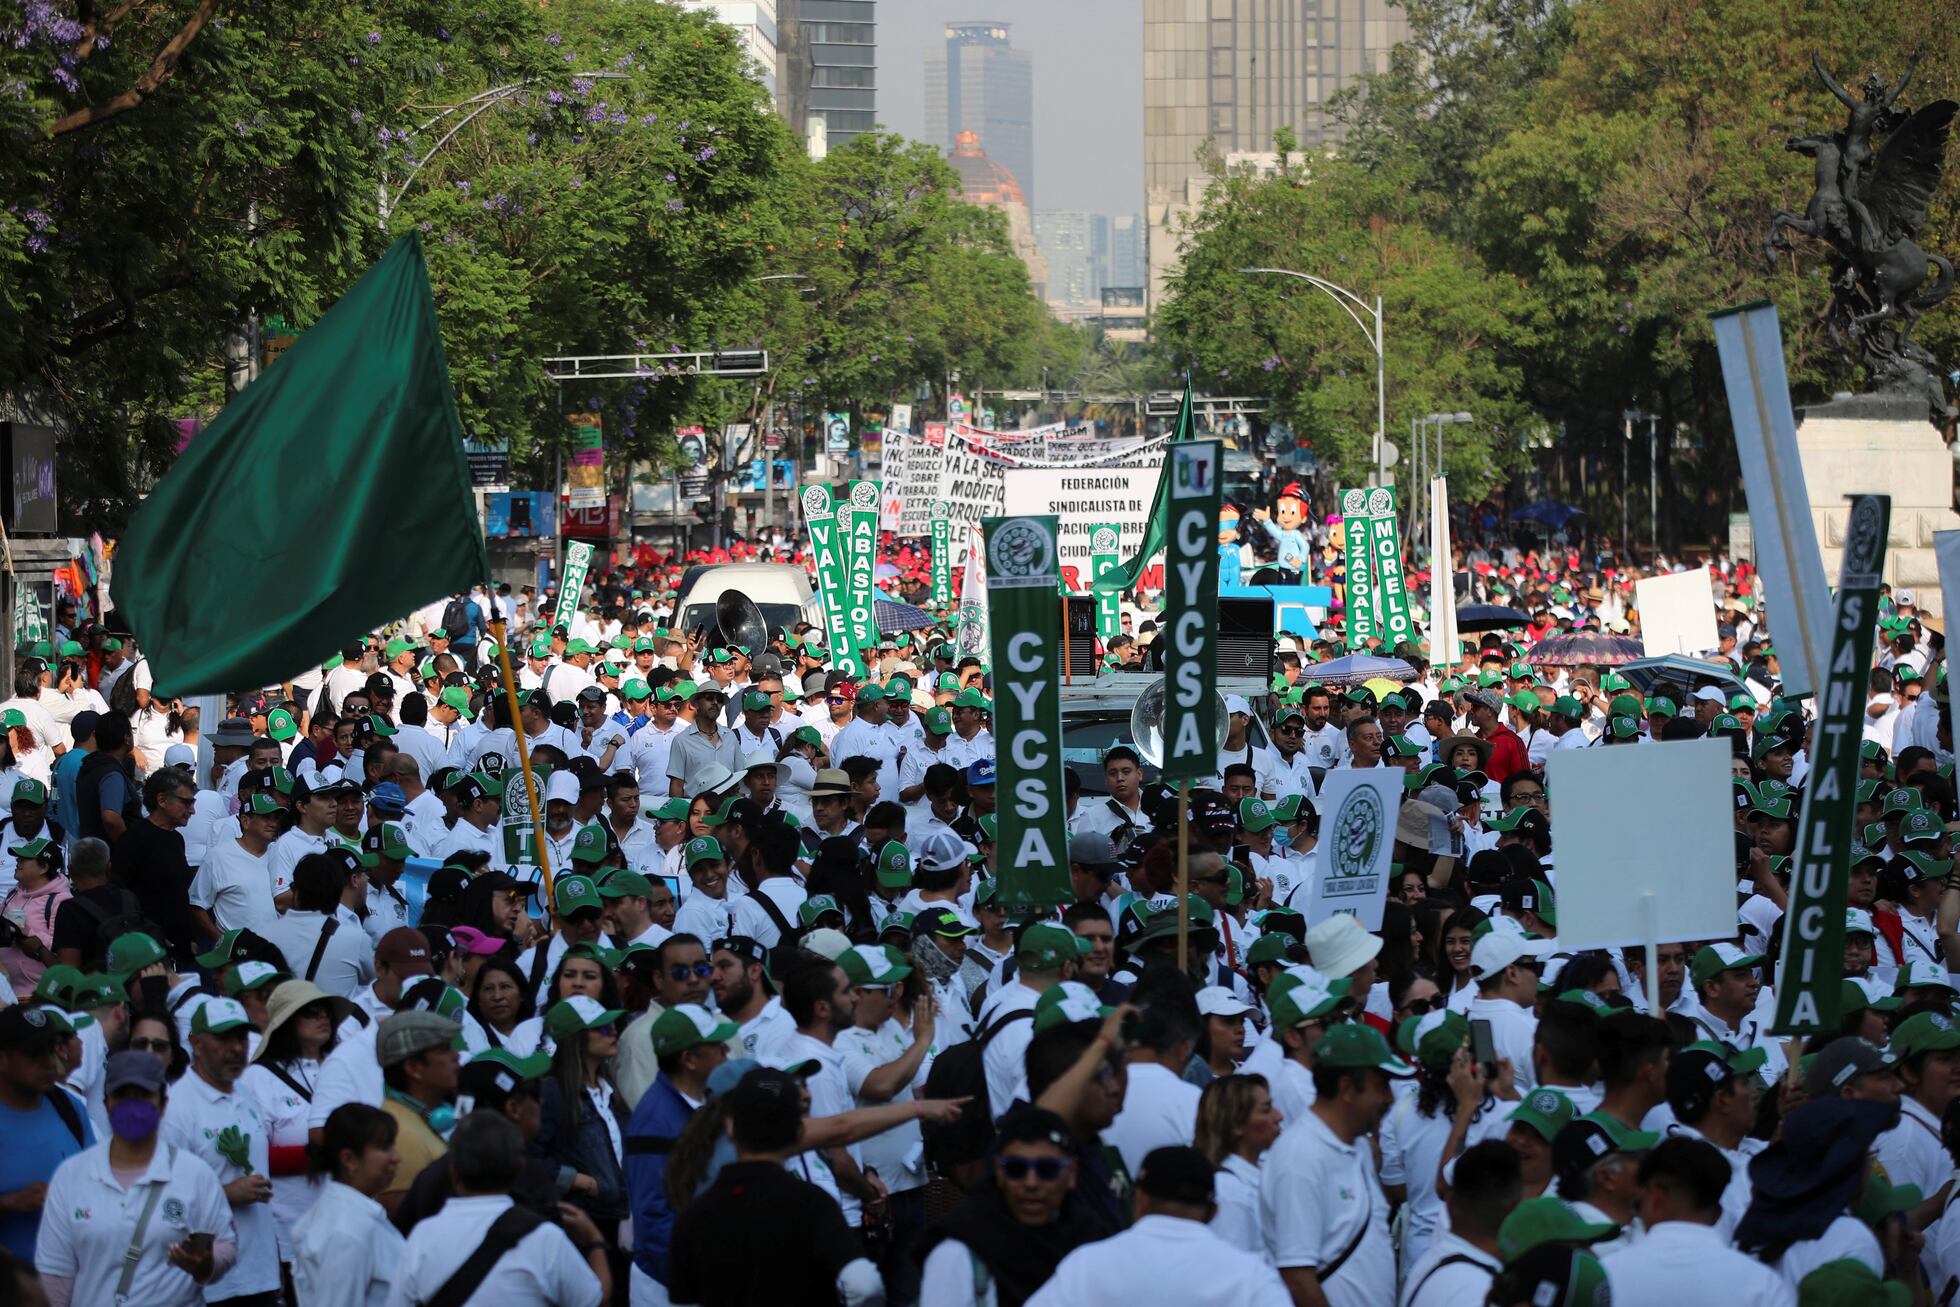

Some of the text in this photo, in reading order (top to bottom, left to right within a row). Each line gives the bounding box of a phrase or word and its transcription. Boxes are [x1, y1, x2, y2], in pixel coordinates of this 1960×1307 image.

[911, 473, 940, 483] SOBRE
[947, 502, 989, 523] ORQUE
[1049, 500, 1142, 513] SINDICALISTA DE
[1061, 476, 1129, 490] FEDERACIÓN
[812, 525, 856, 676] VALLEJO
[850, 521, 873, 640] ABASTOS
[934, 522, 949, 602] CULHUACAN
[1349, 521, 1370, 645] ATZACOALCO
[1174, 510, 1208, 758] CYCSA
[1007, 632, 1056, 868] CYCSA
[1815, 597, 1863, 800] SANTA
[1789, 821, 1832, 1026] LUCIA
